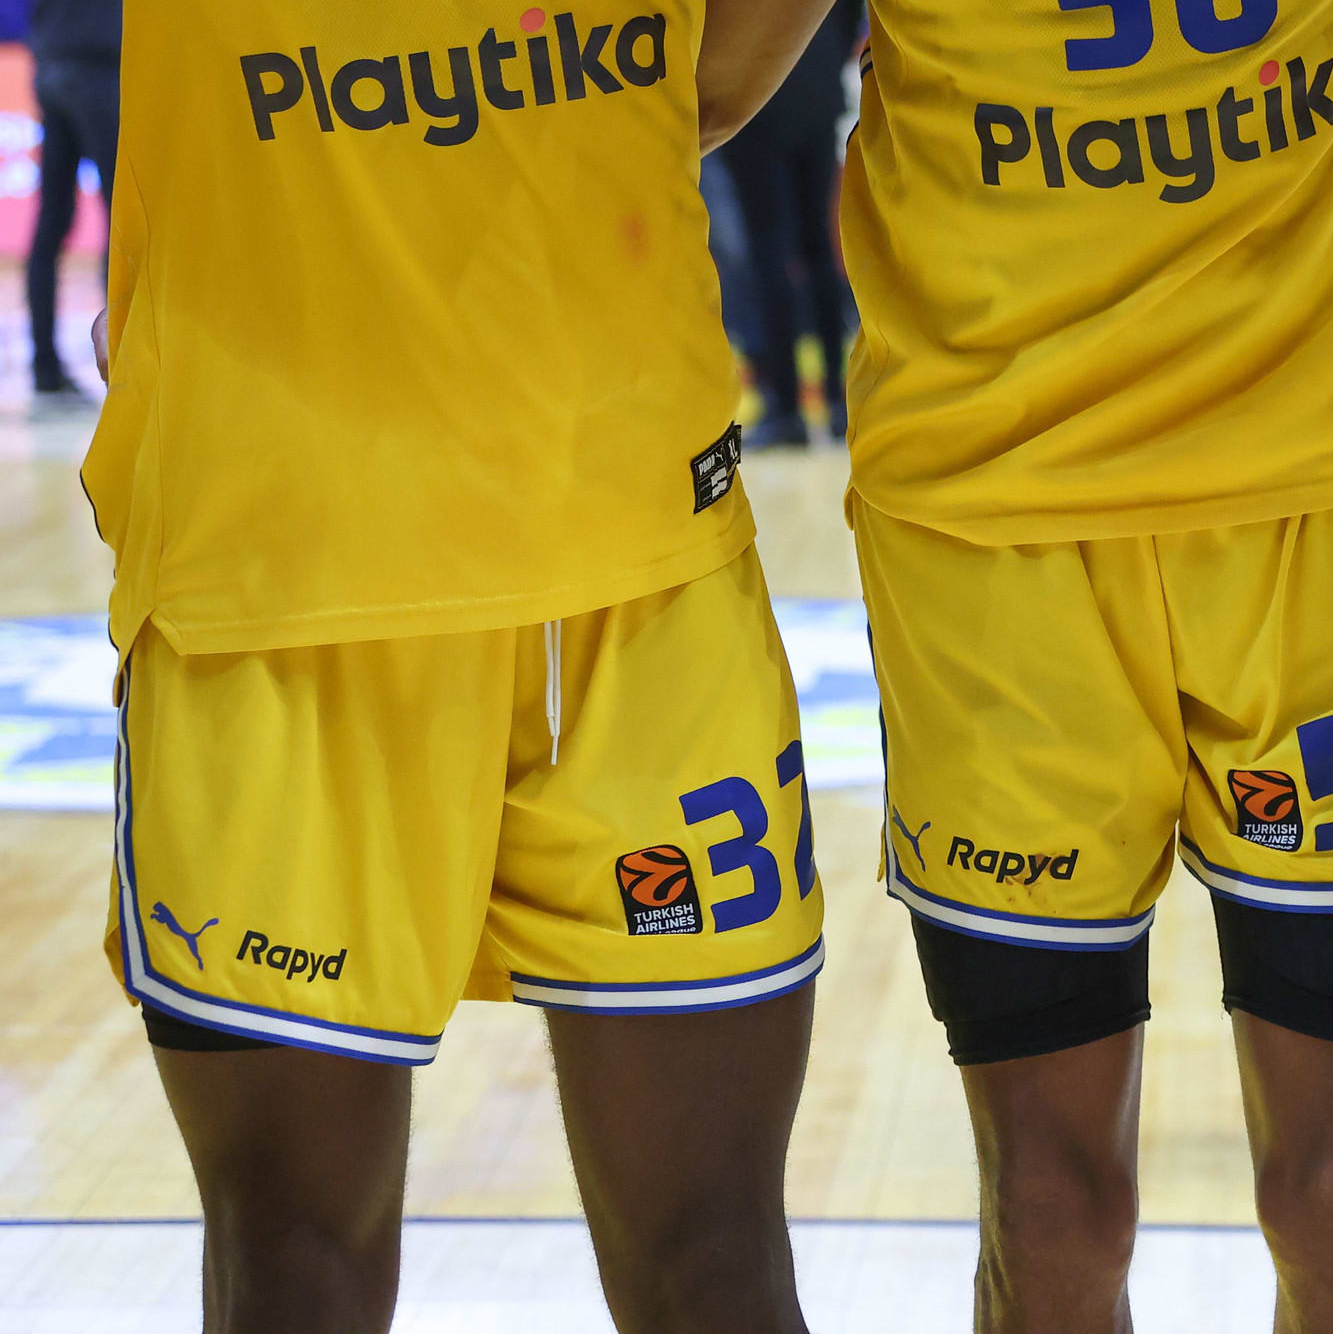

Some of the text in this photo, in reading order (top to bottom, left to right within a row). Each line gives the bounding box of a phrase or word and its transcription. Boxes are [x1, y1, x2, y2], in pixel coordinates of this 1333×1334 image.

[239, 7, 667, 146] Playtika
[1244, 824, 1297, 834] TURKISH
[946, 836, 1079, 884] Rapyd
[634, 903, 694, 923] TURKISH
[636, 915, 695, 934] AIRLINES
[235, 930, 348, 981] Rapyd
